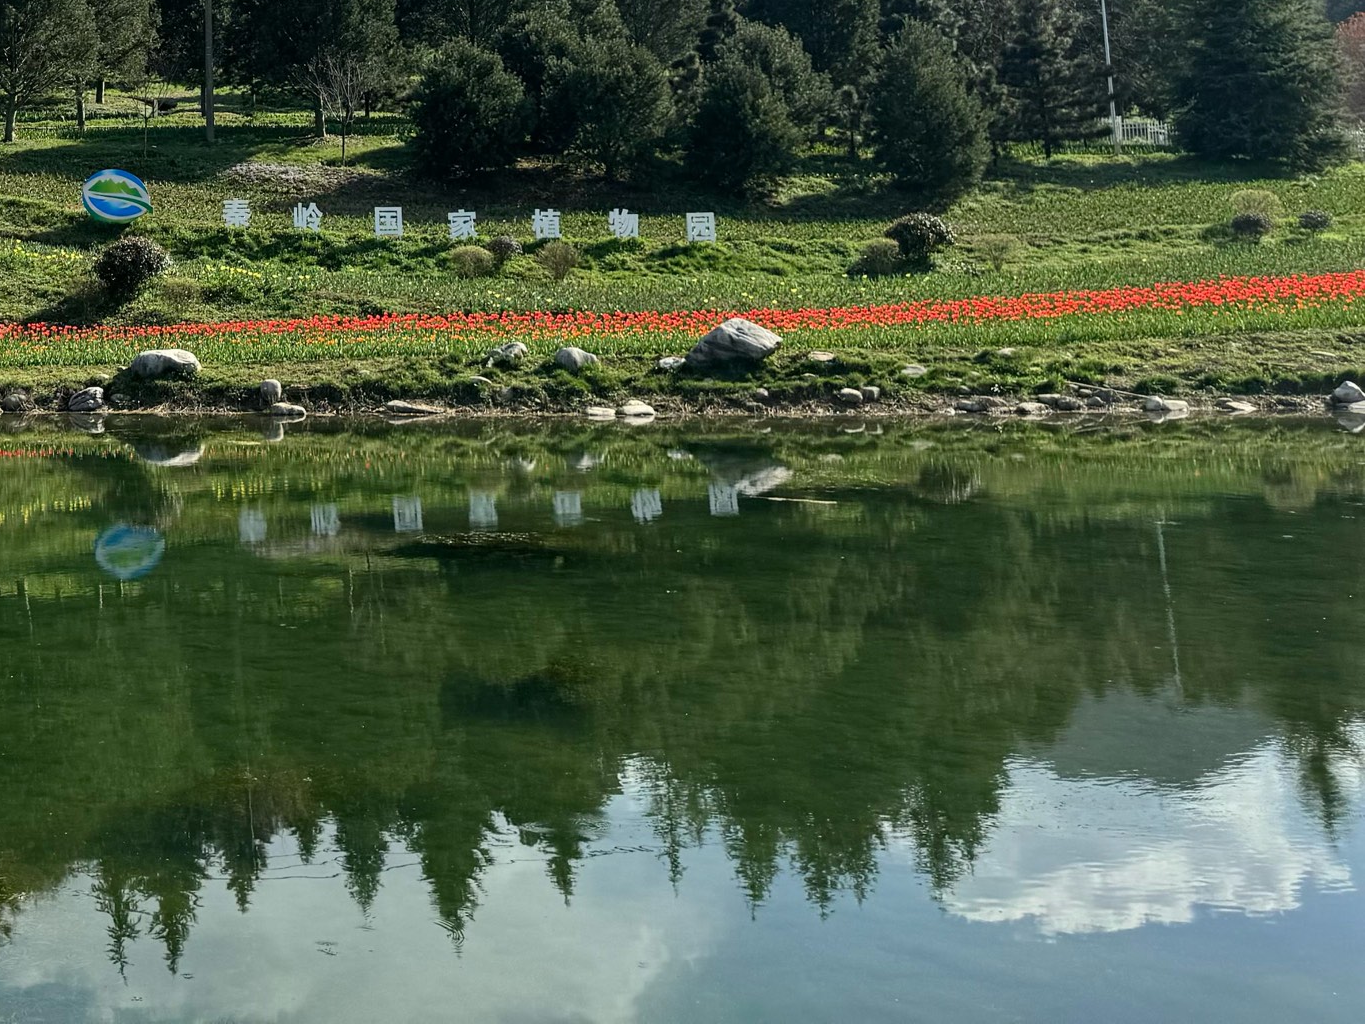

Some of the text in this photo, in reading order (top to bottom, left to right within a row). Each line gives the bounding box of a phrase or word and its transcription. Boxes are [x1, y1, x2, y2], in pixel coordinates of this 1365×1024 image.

[222, 198, 717, 242] 秦岭国家植物园
